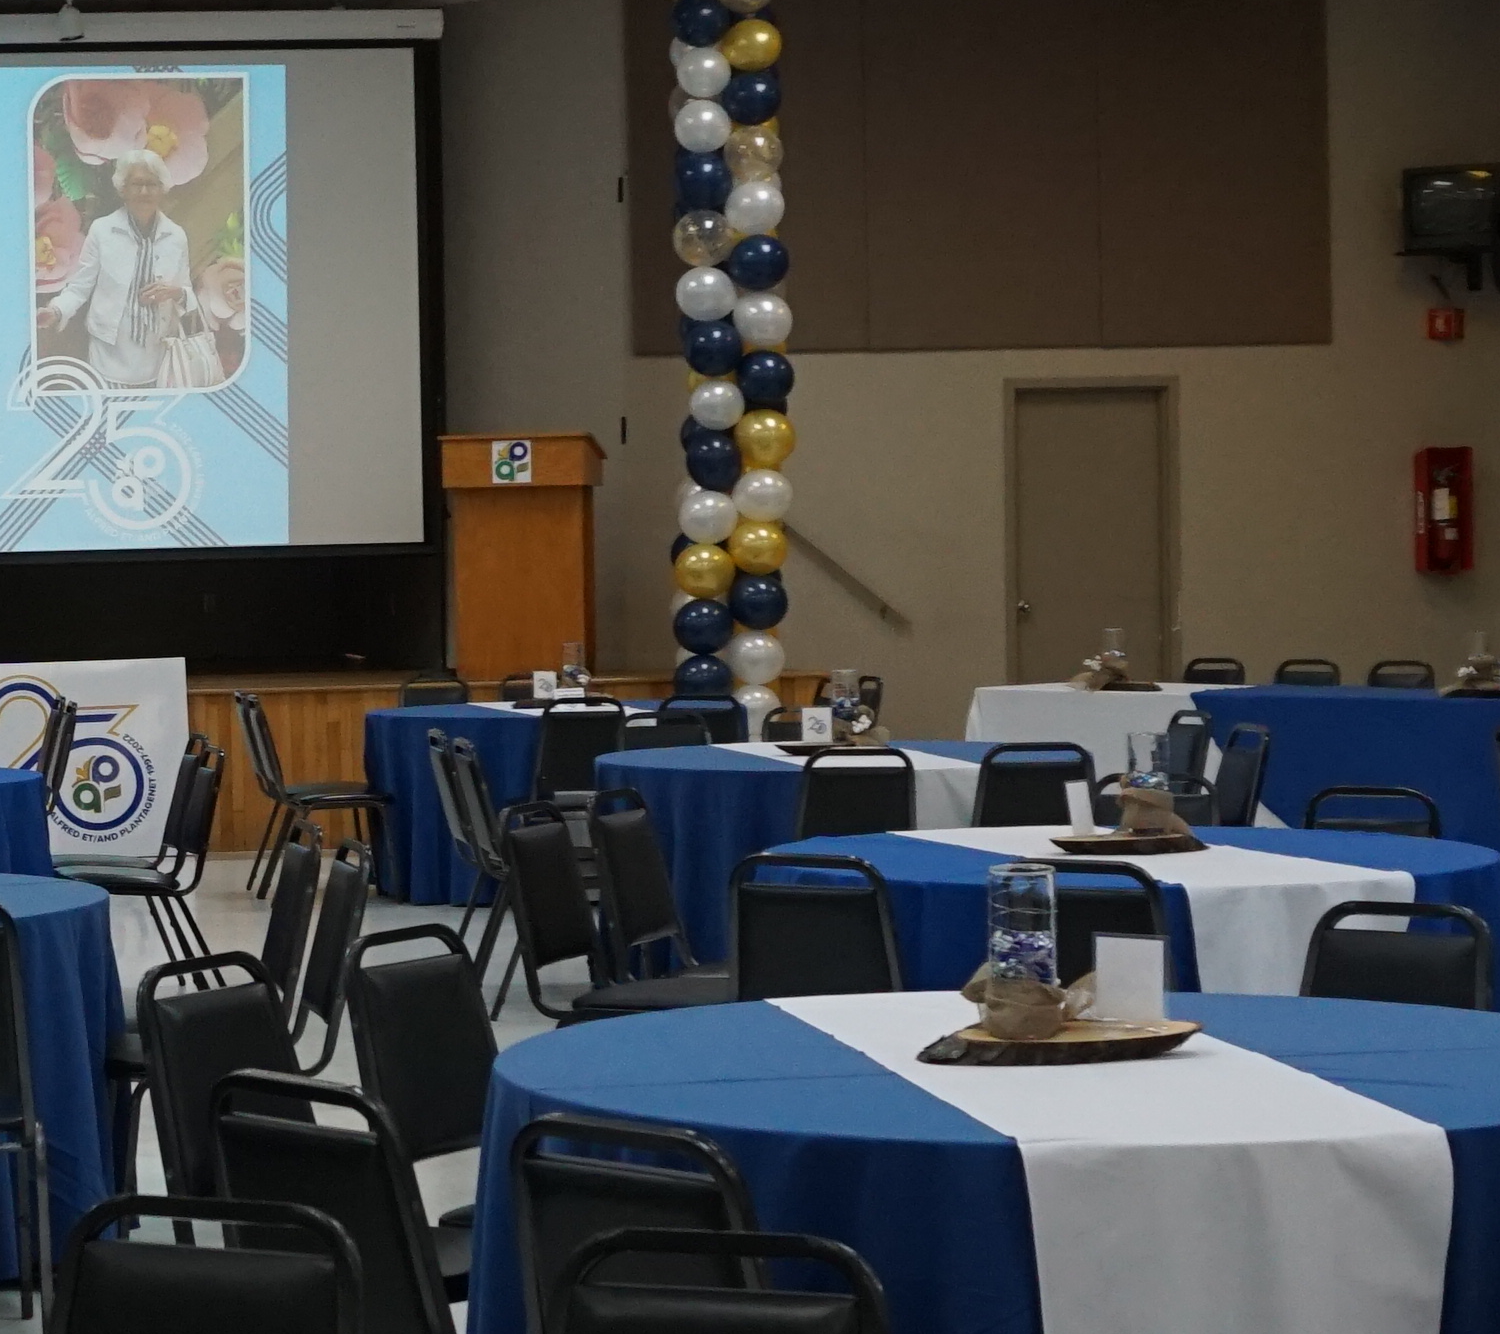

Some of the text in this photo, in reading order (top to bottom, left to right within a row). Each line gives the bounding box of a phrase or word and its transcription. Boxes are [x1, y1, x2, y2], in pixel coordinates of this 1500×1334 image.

[50, 733, 157, 843] ALFRED ET/AND PLANTAGENET 1997-2022
